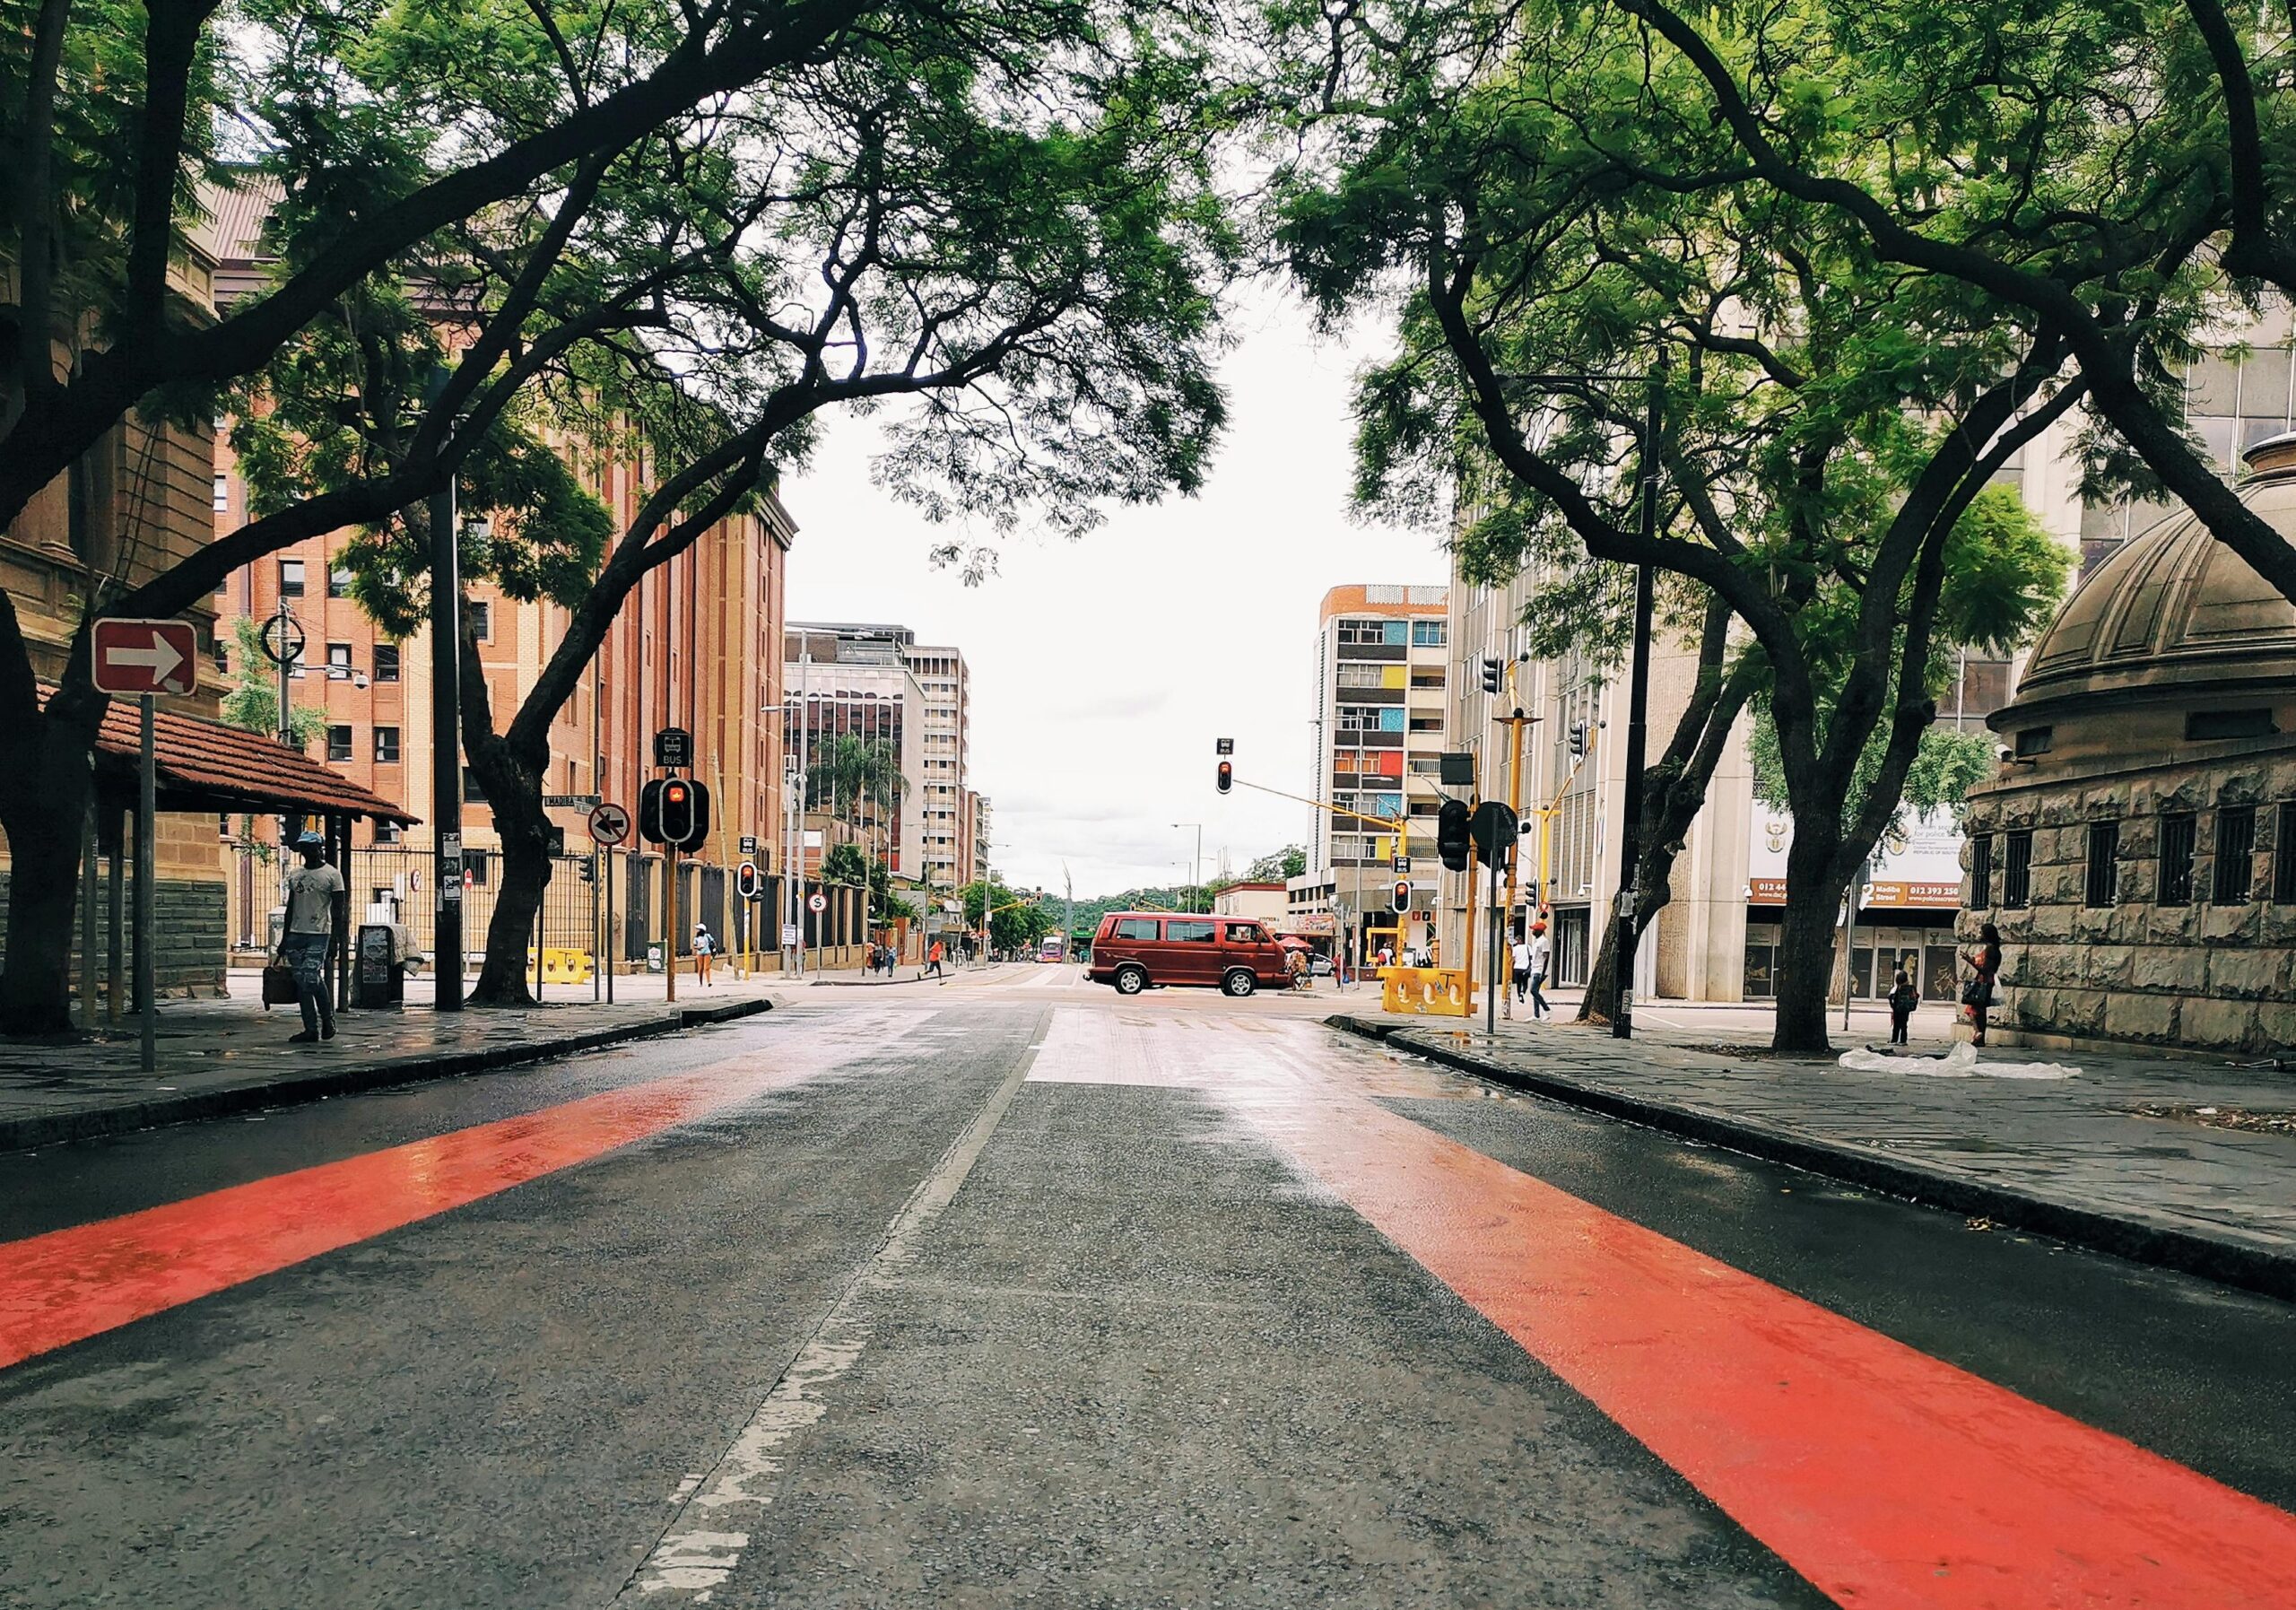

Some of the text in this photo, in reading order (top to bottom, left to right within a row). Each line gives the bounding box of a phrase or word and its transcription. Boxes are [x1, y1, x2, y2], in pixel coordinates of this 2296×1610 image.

[664, 755, 682, 764] BUS
[545, 796, 575, 805] MADIBA
[1759, 883, 1775, 891] 012
[1909, 886, 1926, 894] 012
[1875, 893, 1896, 901] Street
[813, 897, 822, 908] S
